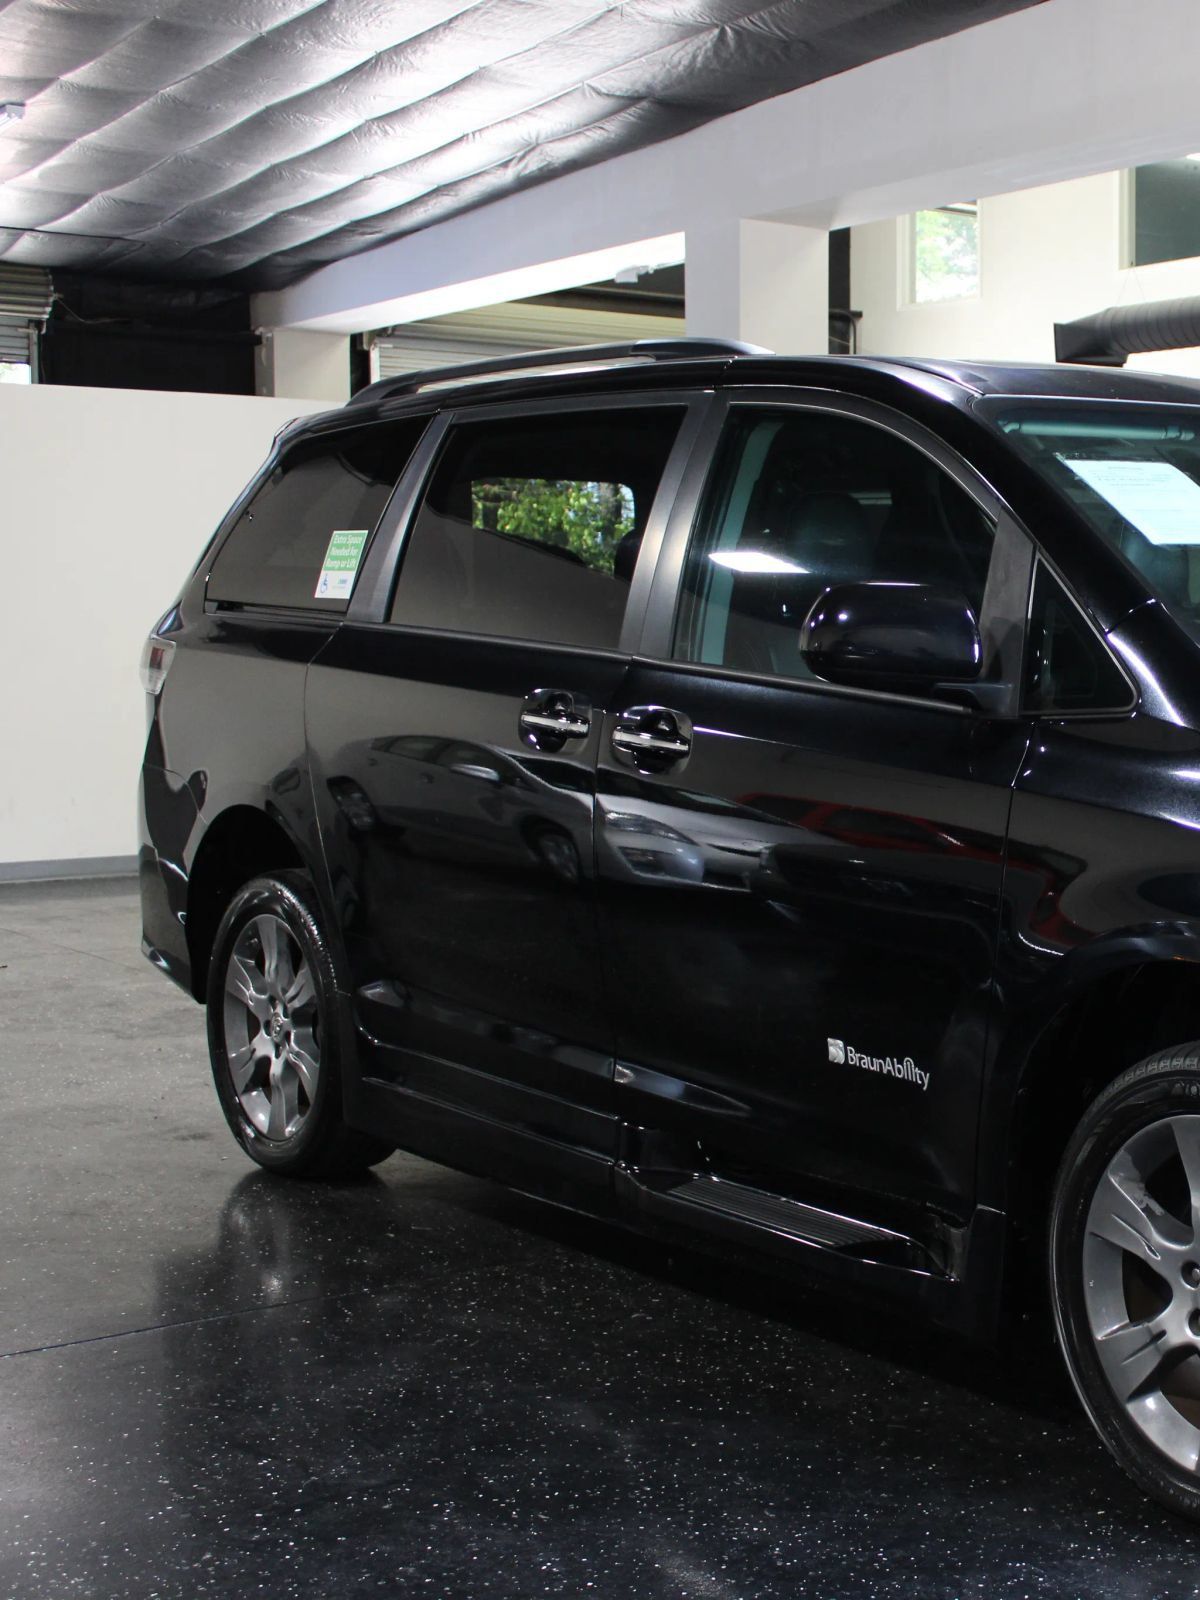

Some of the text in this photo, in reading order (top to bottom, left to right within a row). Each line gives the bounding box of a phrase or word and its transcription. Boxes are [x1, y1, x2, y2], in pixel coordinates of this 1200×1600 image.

[333, 534, 362, 545] Extra Space
[846, 1046, 930, 1091] BraunAbility
